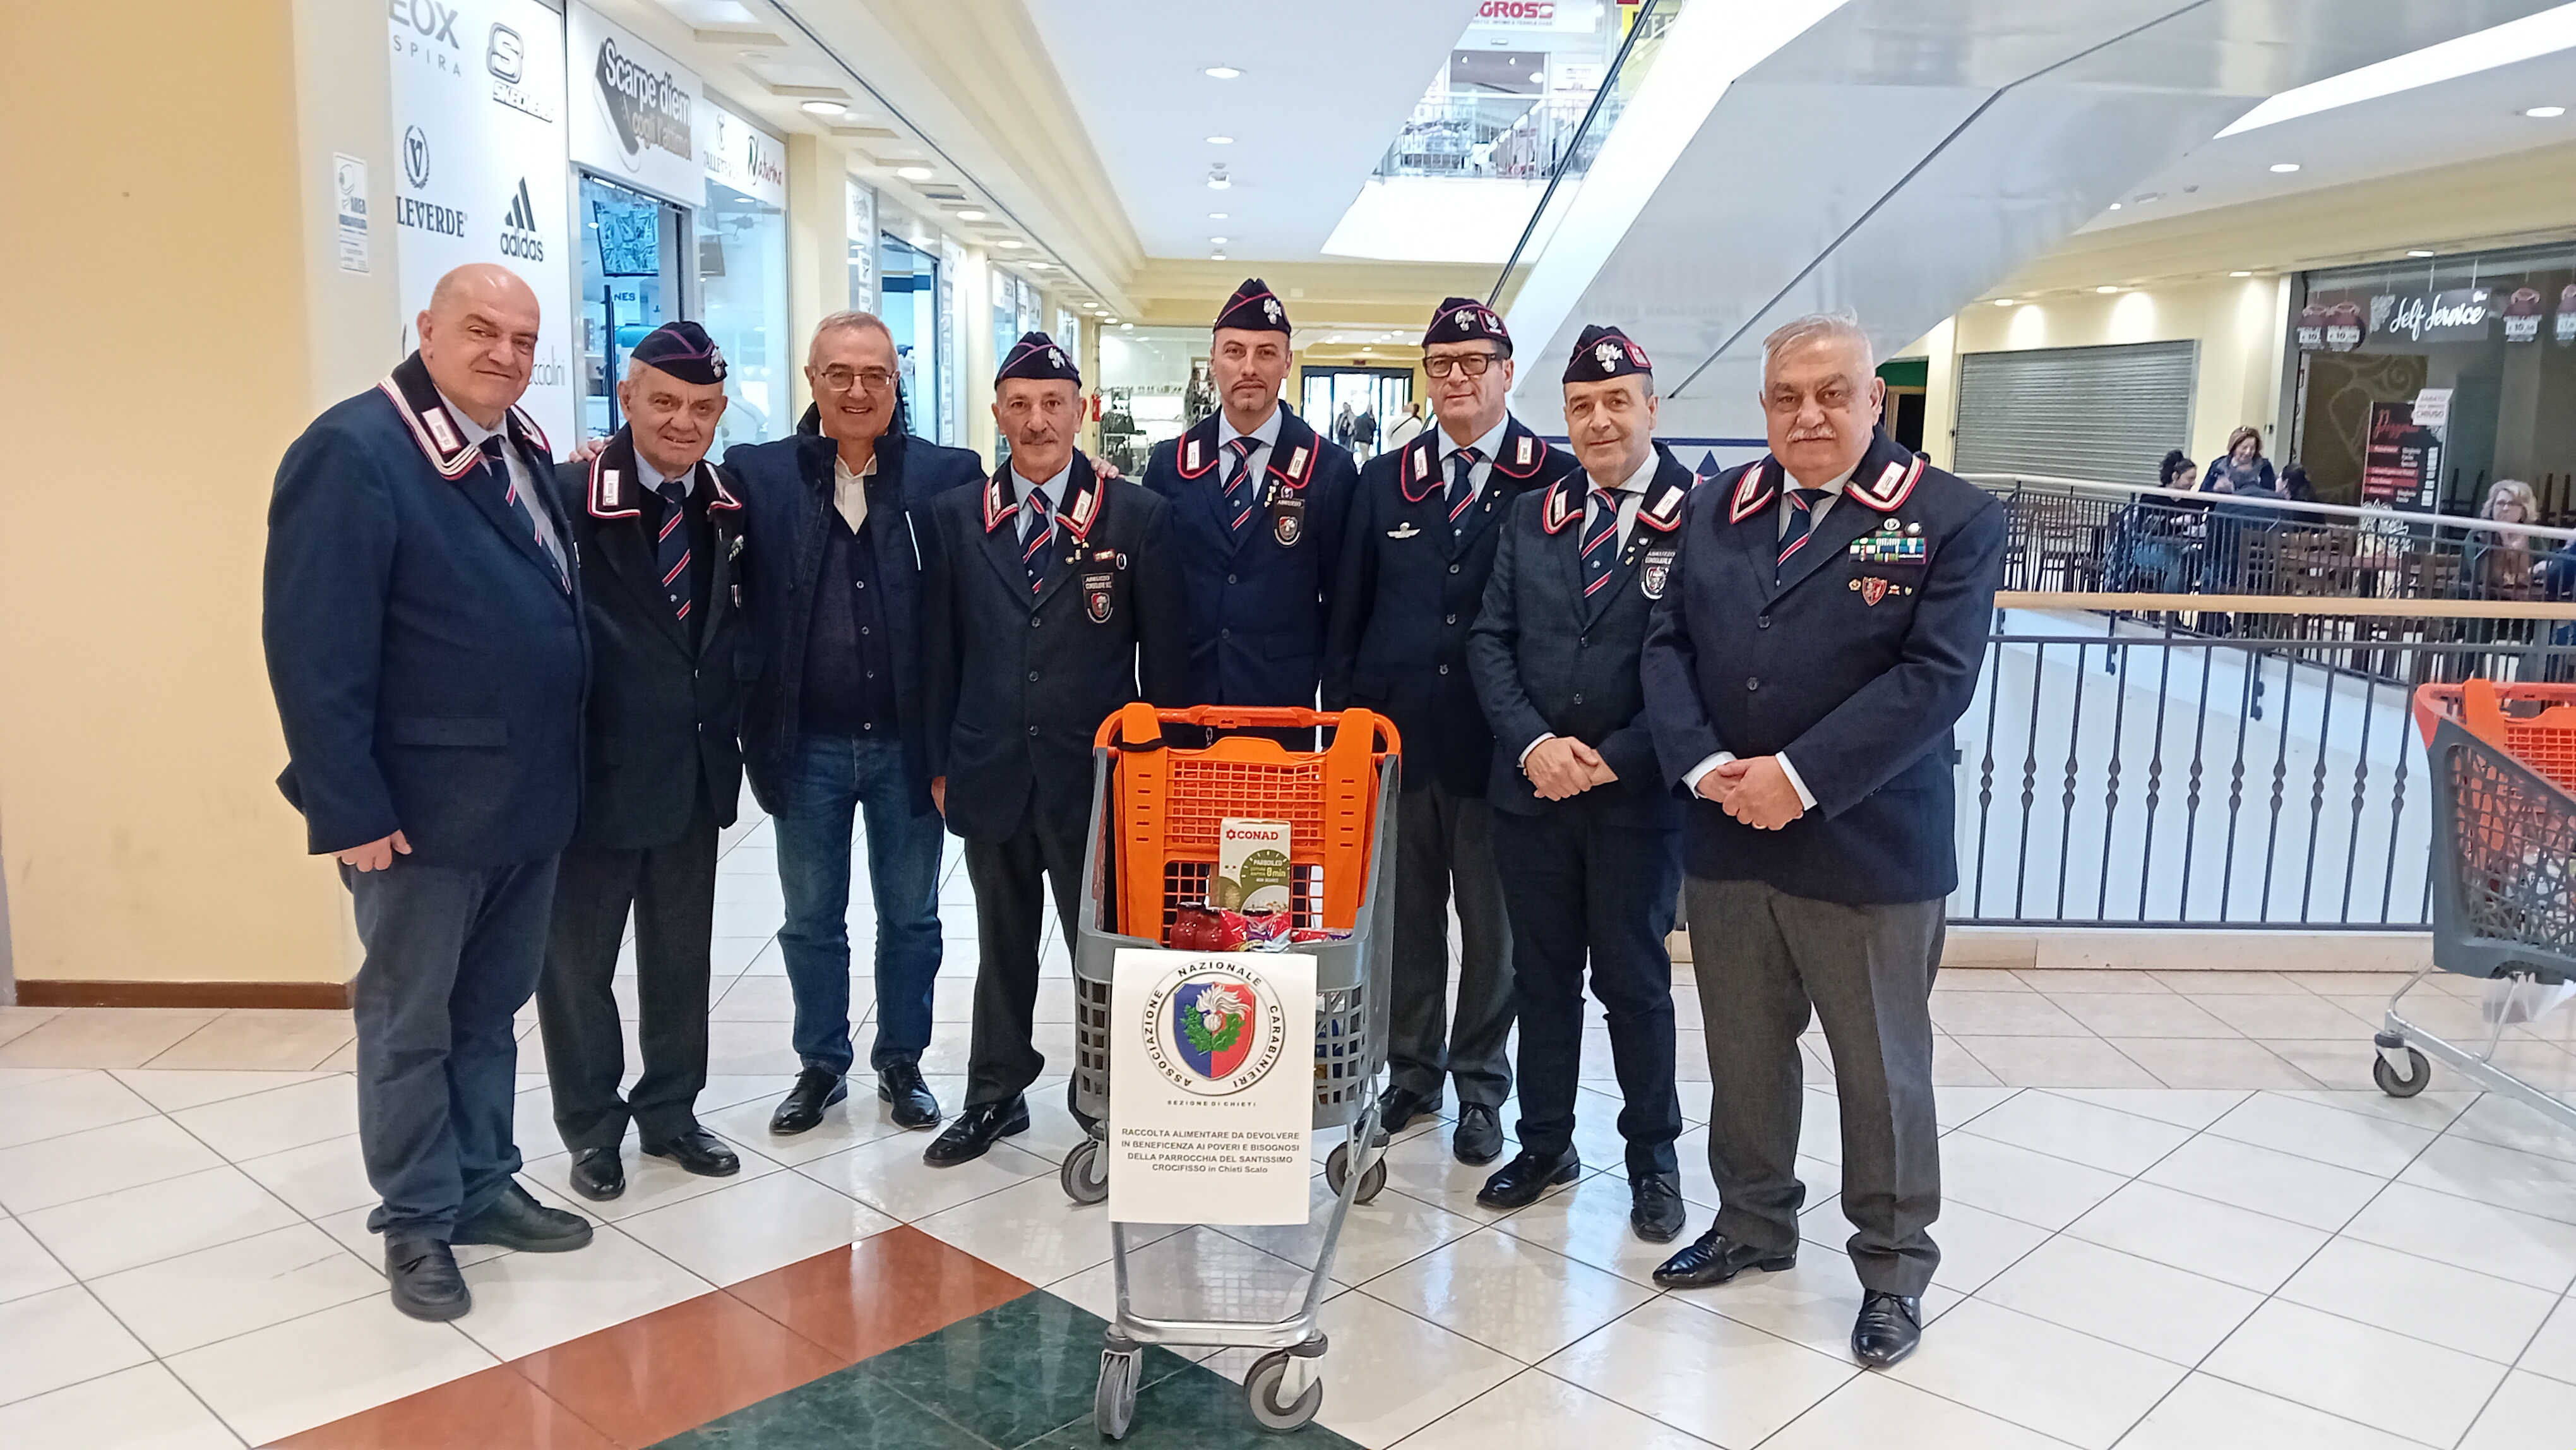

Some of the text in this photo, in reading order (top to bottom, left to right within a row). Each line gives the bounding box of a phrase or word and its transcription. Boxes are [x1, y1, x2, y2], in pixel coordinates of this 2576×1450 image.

[1475, 1, 1554, 18] GROSS
[393, 35, 461, 78] SPIRA
[604, 37, 691, 126] Scarpe diem
[395, 195, 465, 238] LEVERDE
[500, 227, 544, 263] adidas
[2389, 294, 2486, 342] Self Service
[1237, 830, 1279, 840] CONAD
[1178, 961, 1262, 987] NAZIONALE
[1144, 989, 1193, 1087] ASSOCIAZIONE
[1232, 1005, 1281, 1088] CARABINIERI
[1121, 1128, 1171, 1137] RACCOLTA
[1172, 1130, 1229, 1139] ALIMENTARE
[1232, 1131, 1244, 1139] DA
[1133, 1141, 1194, 1150] BENEFICENZA
[1152, 1164, 1206, 1172] CROCIFISSO
[1159, 1154, 1217, 1162] PARROCCHIA
